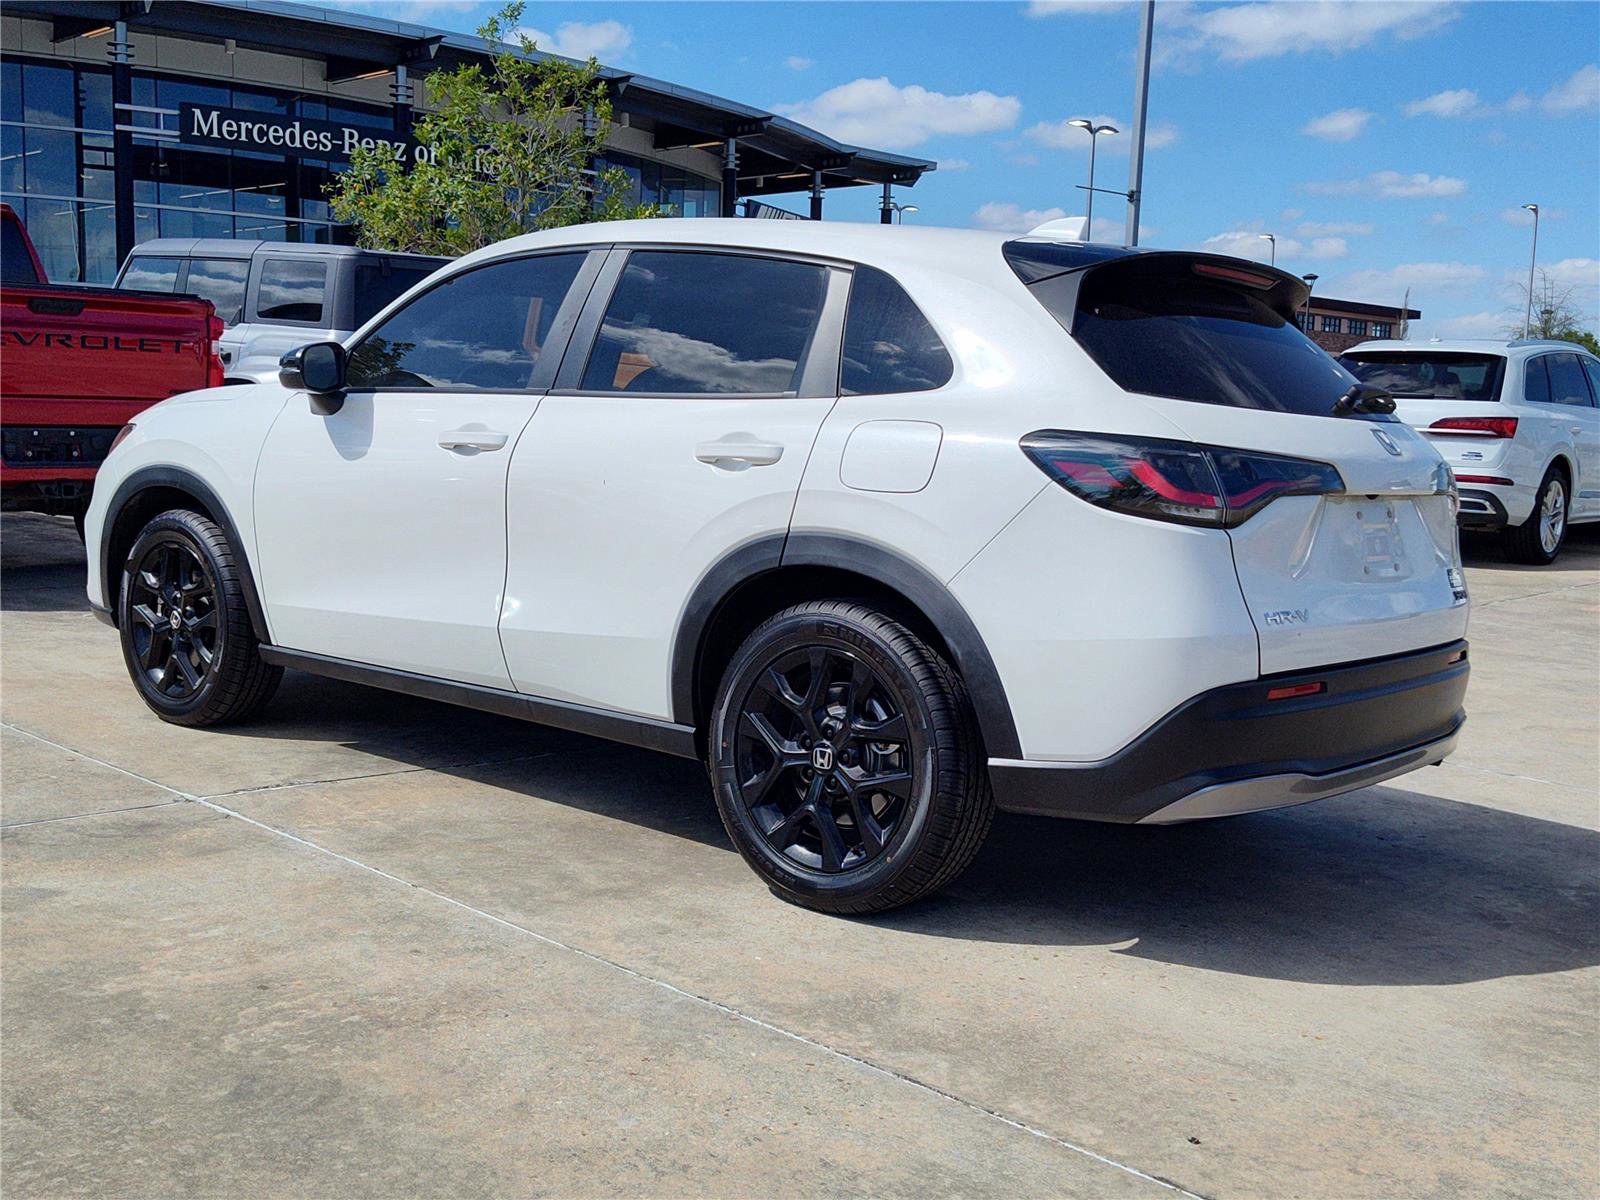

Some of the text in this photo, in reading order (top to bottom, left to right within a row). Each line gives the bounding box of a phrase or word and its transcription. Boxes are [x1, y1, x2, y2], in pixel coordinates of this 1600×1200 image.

[414, 141, 440, 166] of
[0, 330, 194, 353] VROLET
[1264, 609, 1309, 625] HR-V
